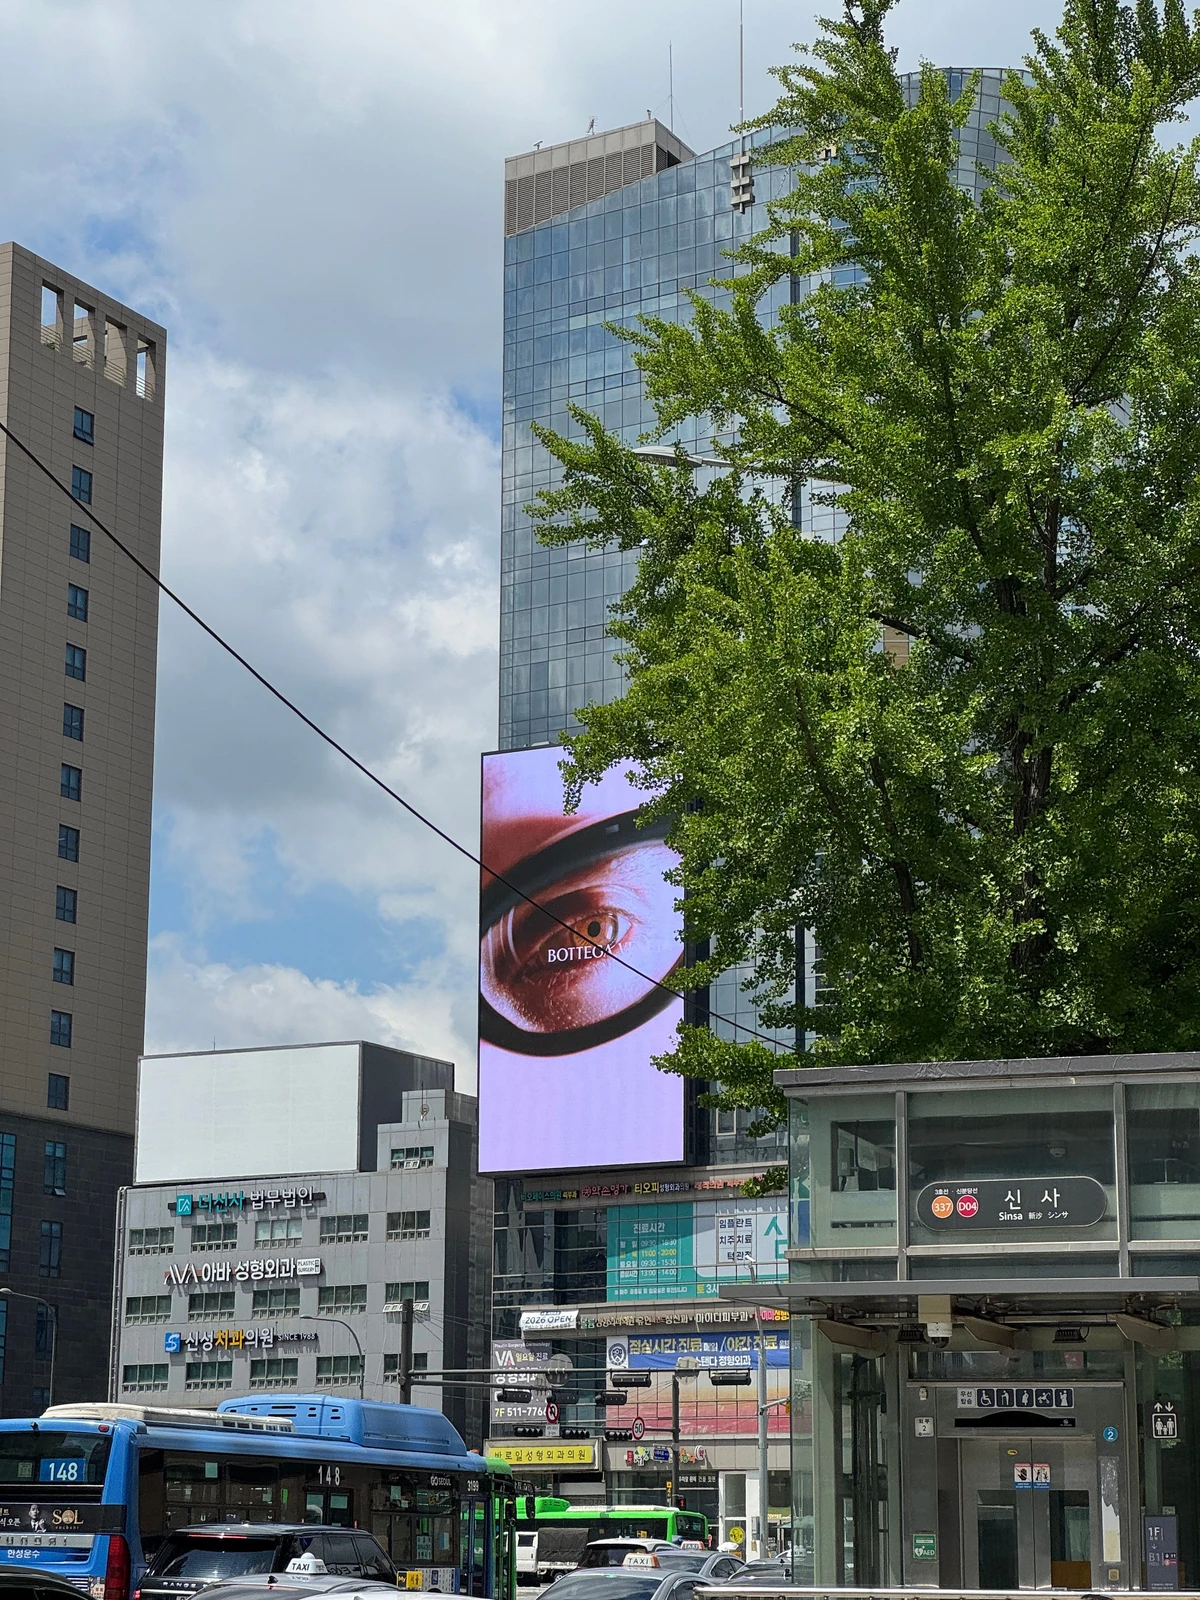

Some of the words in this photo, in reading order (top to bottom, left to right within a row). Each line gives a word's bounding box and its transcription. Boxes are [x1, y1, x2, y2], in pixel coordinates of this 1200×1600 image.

[592, 1183, 629, 1197] 약손명가
[634, 1182, 659, 1194] 티오피
[956, 1187, 978, 1195] 신분당선
[198, 1190, 245, 1213] 더신사
[250, 1186, 314, 1210] 법무법인
[934, 1202, 951, 1212] 337
[958, 1201, 978, 1211] D04
[998, 1212, 1023, 1221] Sinsa
[1028, 1212, 1043, 1220] 新沙
[1048, 1210, 1069, 1219] シンサ
[633, 1222, 665, 1234] 진료시간
[719, 1218, 752, 1229] 임플란트
[719, 1235, 752, 1245] 치주치료
[202, 1261, 232, 1282] 아바
[235, 1257, 296, 1281] 성형외과
[525, 1316, 545, 1325] 2026
[547, 1315, 573, 1324] OPEN
[185, 1327, 275, 1352] 신성치과의원
[278, 1333, 298, 1341] SINCE
[629, 1338, 676, 1354] 점심시간
[678, 1337, 702, 1352] 진료
[727, 1336, 752, 1351] 야간
[515, 1352, 535, 1362] 일요일
[718, 1355, 752, 1367] 정형외과
[960, 1390, 973, 1398] 우선
[494, 1408, 505, 1417] 7F
[634, 1424, 643, 1434] 50
[922, 1424, 927, 1432] 2
[1107, 1431, 1114, 1440] 2
[494, 1449, 586, 1462] 바로일성형외과의원
[49, 1461, 78, 1481] 148
[317, 1465, 341, 1486] 148
[438, 1477, 451, 1486] SEOUL
[466, 1480, 479, 1492] 3199
[52, 1508, 84, 1525] SOL
[1148, 1527, 1160, 1537] 1F
[628, 1557, 649, 1565] TAXI
[1149, 1552, 1160, 1562] B1
[292, 1563, 310, 1571] TAXI
